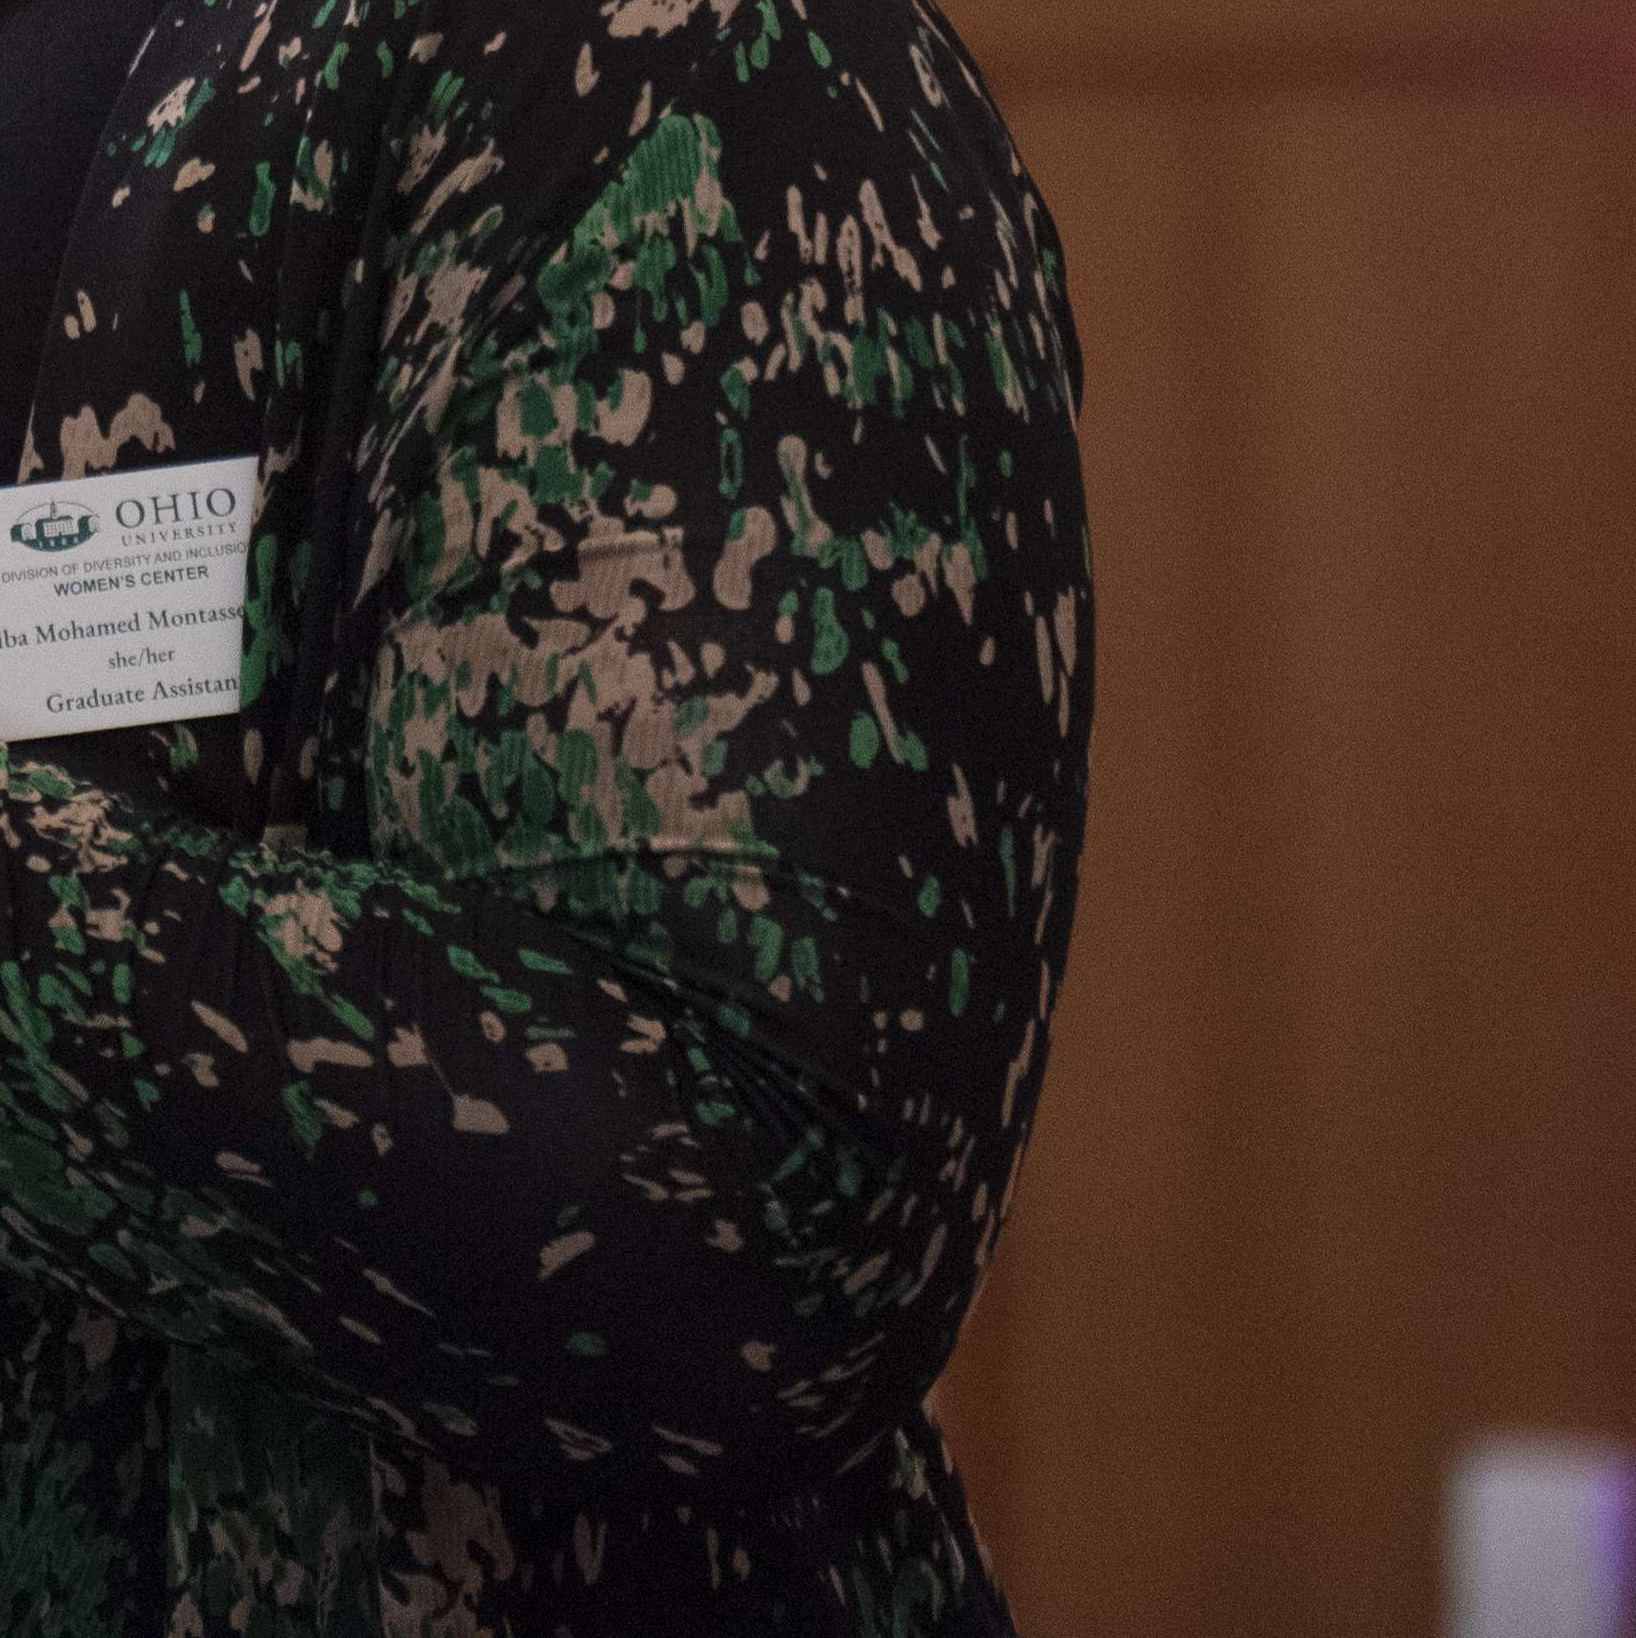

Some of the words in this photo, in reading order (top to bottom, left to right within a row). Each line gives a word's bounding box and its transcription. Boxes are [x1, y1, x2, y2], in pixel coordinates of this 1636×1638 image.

[115, 488, 237, 530] OHIO
[121, 521, 237, 547] UNIVERSITY
[1, 565, 58, 584] DIVISION
[61, 564, 79, 577] OF
[83, 553, 151, 574] DIVERSITY
[155, 549, 183, 563] AND
[53, 574, 136, 598] WOMEN'S
[140, 565, 209, 586] CENTER
[35, 611, 142, 645] Mohamed
[107, 646, 176, 672] she/her
[46, 687, 145, 714] Graduate
